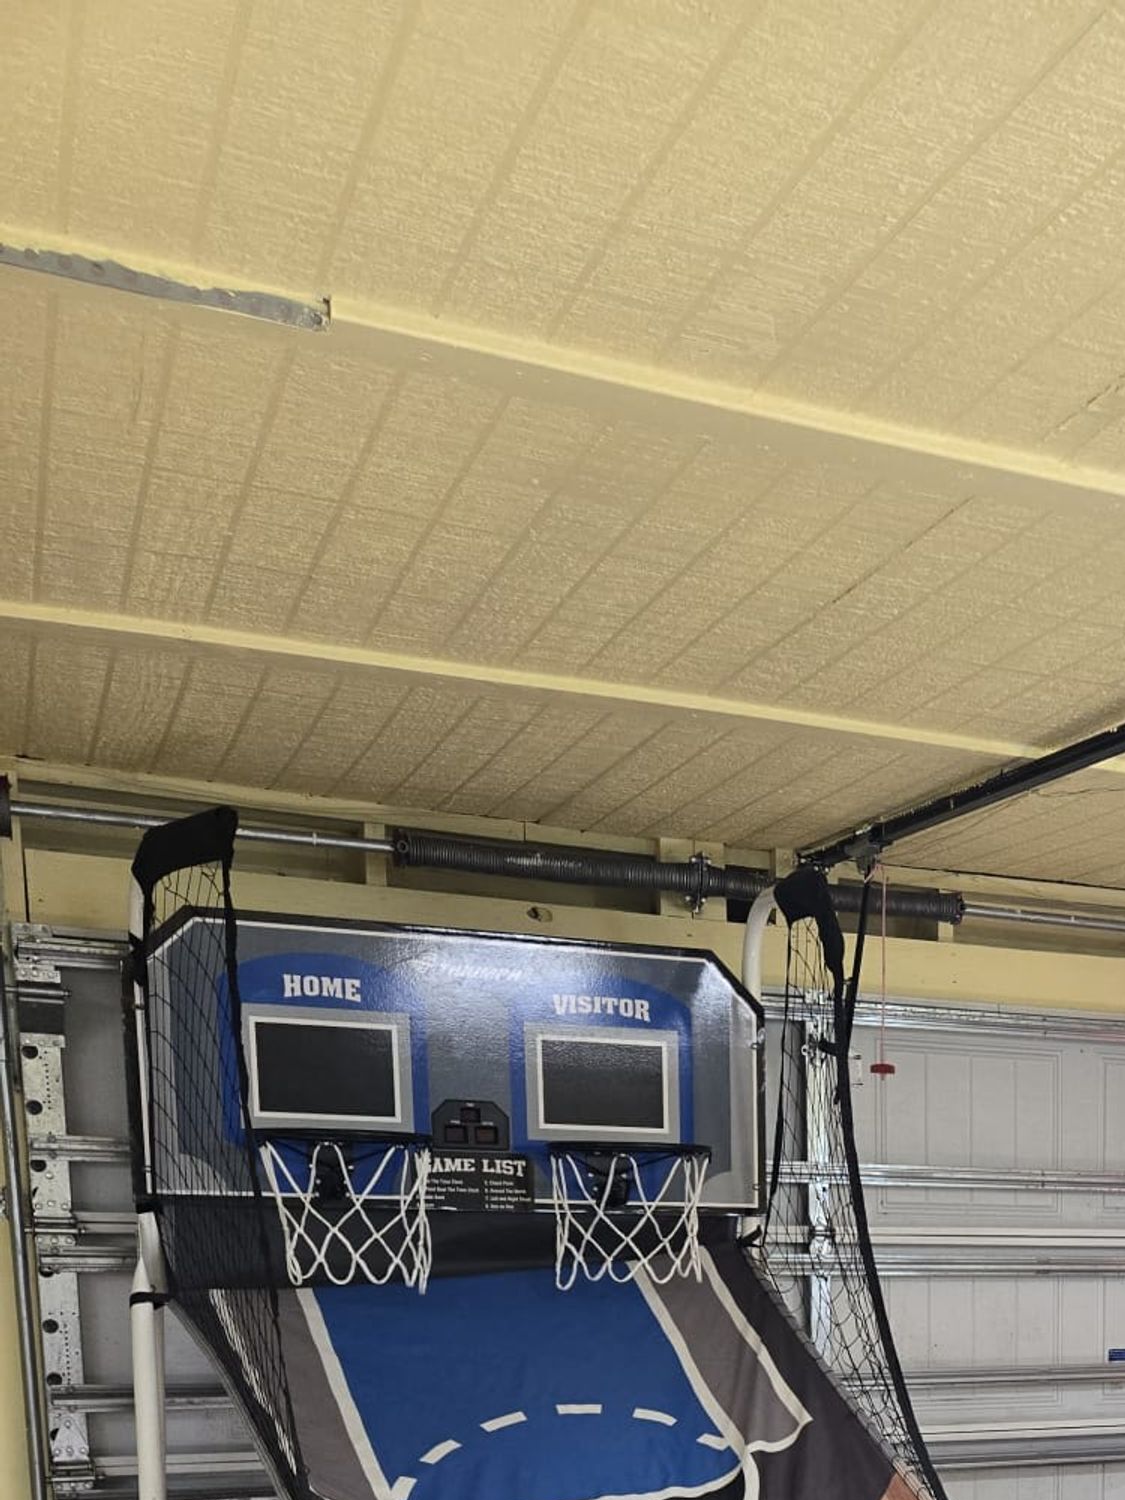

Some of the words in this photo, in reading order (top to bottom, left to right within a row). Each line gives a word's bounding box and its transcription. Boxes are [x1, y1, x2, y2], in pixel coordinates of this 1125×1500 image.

[283, 973, 361, 1002] HOME
[551, 994, 651, 1022] VISITOR
[425, 1157, 475, 1173] AME
[481, 1159, 526, 1177] LIST
